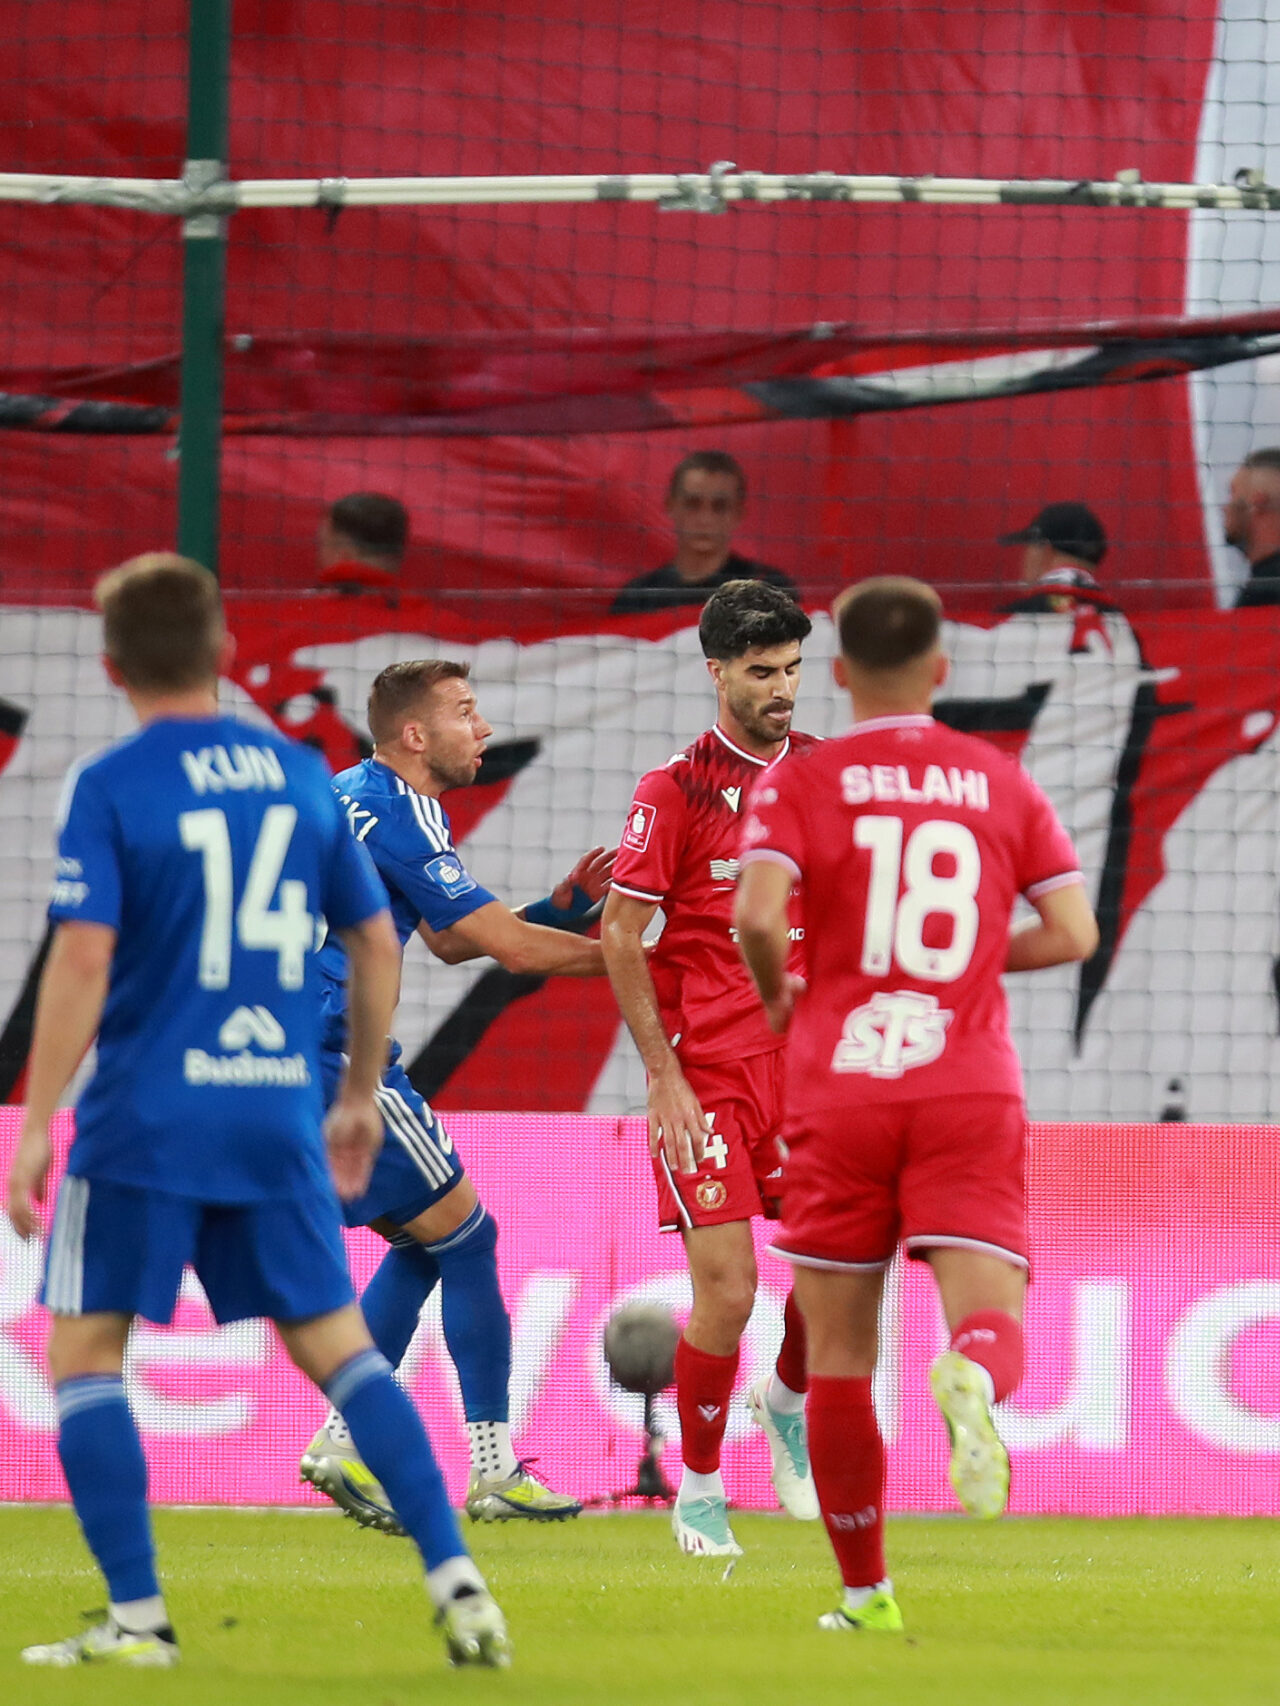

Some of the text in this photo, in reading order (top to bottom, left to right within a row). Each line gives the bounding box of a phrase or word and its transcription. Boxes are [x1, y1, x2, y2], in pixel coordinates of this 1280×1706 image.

[181, 747, 286, 793] KUN
[840, 764, 990, 812] SELAHI
[180, 804, 319, 990] 14
[853, 815, 980, 982] 18
[831, 990, 953, 1079] STS
